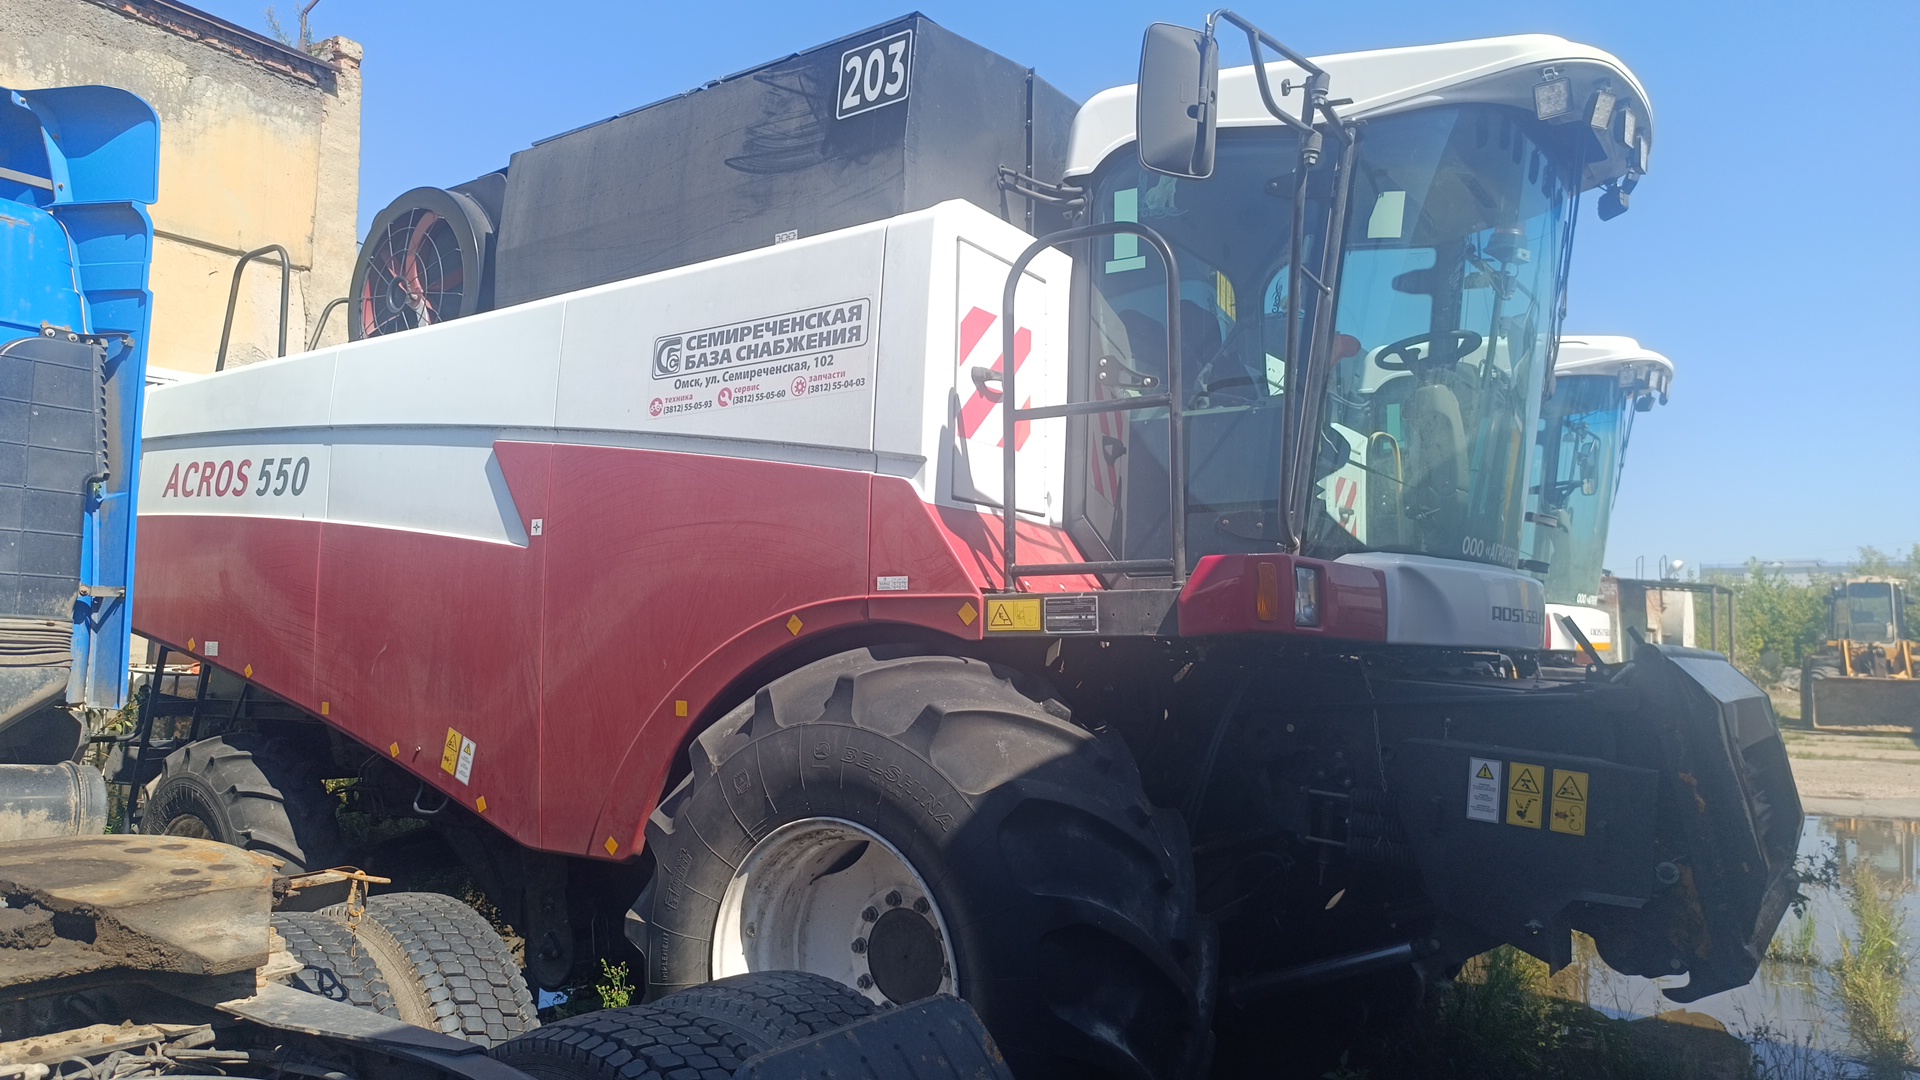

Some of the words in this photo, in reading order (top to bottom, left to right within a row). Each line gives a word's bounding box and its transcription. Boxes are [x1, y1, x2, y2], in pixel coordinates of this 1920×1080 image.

[842, 40, 906, 110] 203
[686, 304, 862, 351] СЕМИРЕЧЕНСКАЯ
[685, 348, 732, 370] БАЗА
[736, 325, 861, 361] СНАБЖЕНИЯ
[674, 379, 703, 390] Омск,
[705, 375, 720, 388] ул.
[722, 361, 811, 382] Семиреченская,
[814, 354, 834, 368] 102
[808, 370, 846, 383] запчасти
[734, 384, 760, 394] сервис
[807, 382, 831, 394] (3812)
[832, 377, 865, 390] 55-04-03
[665, 394, 693, 404] техника
[732, 394, 754, 405] (3812)
[755, 389, 786, 401] 55-05-60
[663, 404, 683, 415] (3812)
[684, 400, 713, 410] 55-05-93
[162, 459, 252, 498] ACROS
[256, 456, 310, 496] 550
